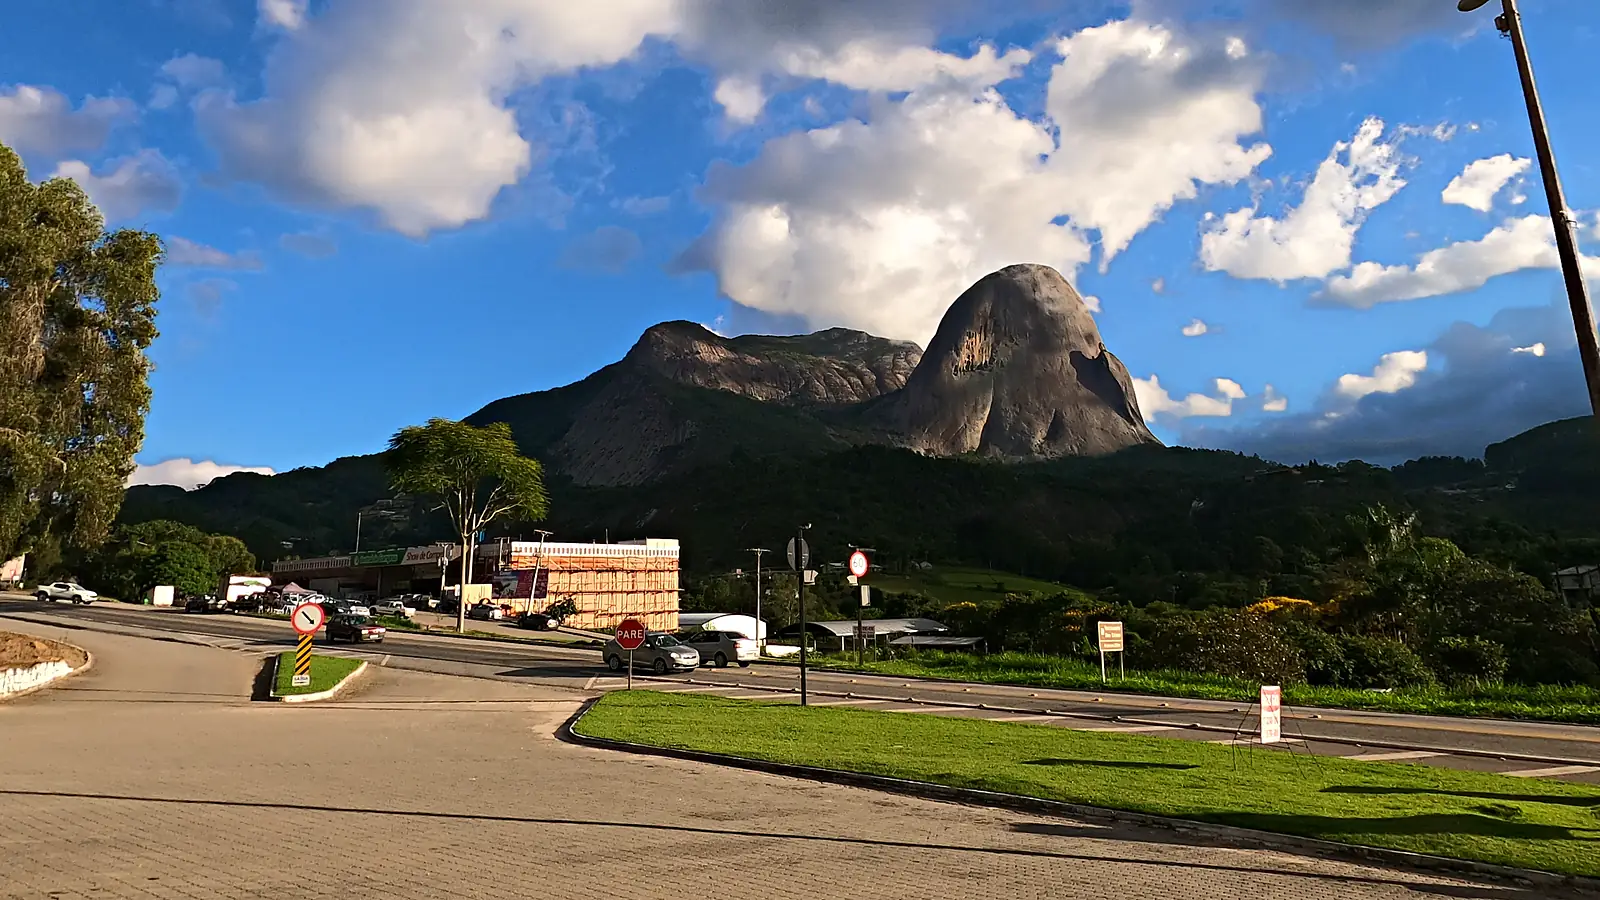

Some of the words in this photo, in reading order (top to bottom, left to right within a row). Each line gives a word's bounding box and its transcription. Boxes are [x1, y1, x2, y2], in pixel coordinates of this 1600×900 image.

[419, 551, 426, 560] de
[853, 558, 863, 568] 60
[617, 630, 643, 639] PARE
